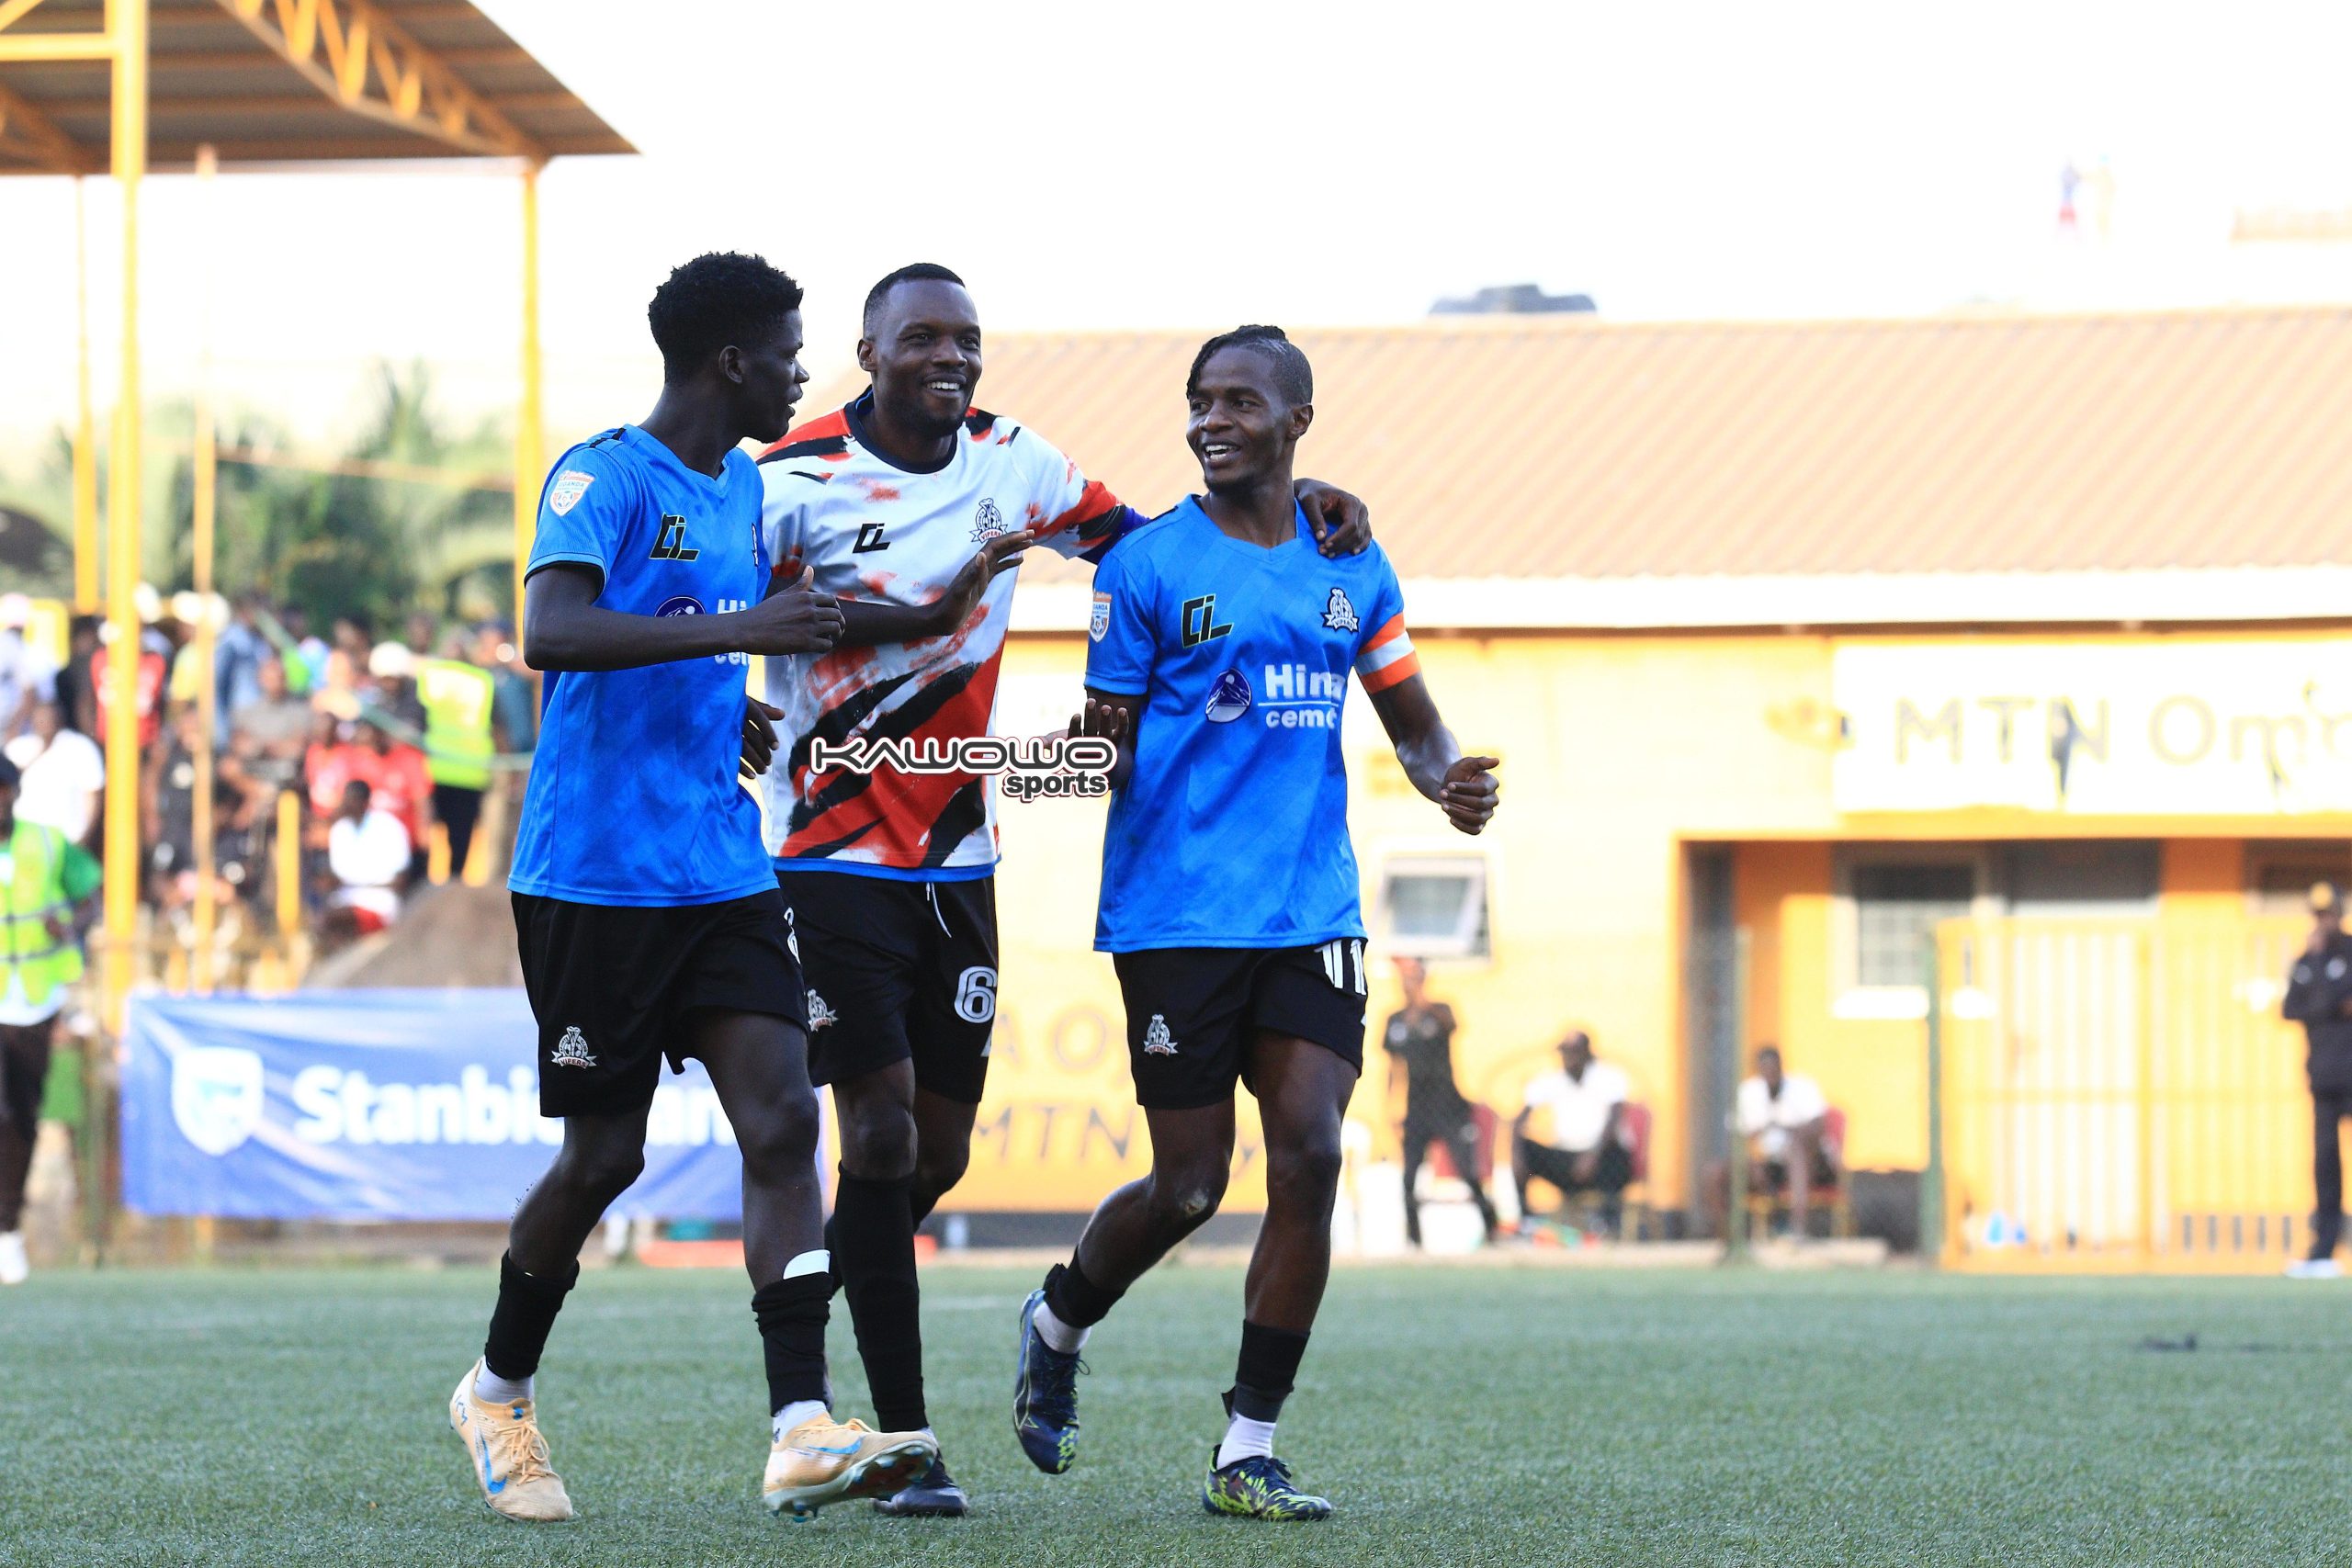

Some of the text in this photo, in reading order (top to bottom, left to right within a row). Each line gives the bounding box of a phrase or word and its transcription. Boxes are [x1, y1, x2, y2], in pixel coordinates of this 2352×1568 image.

[1894, 695, 2111, 764] MTN
[560, 1058, 586, 1067] VIPERS
[645, 1084, 737, 1145] an
